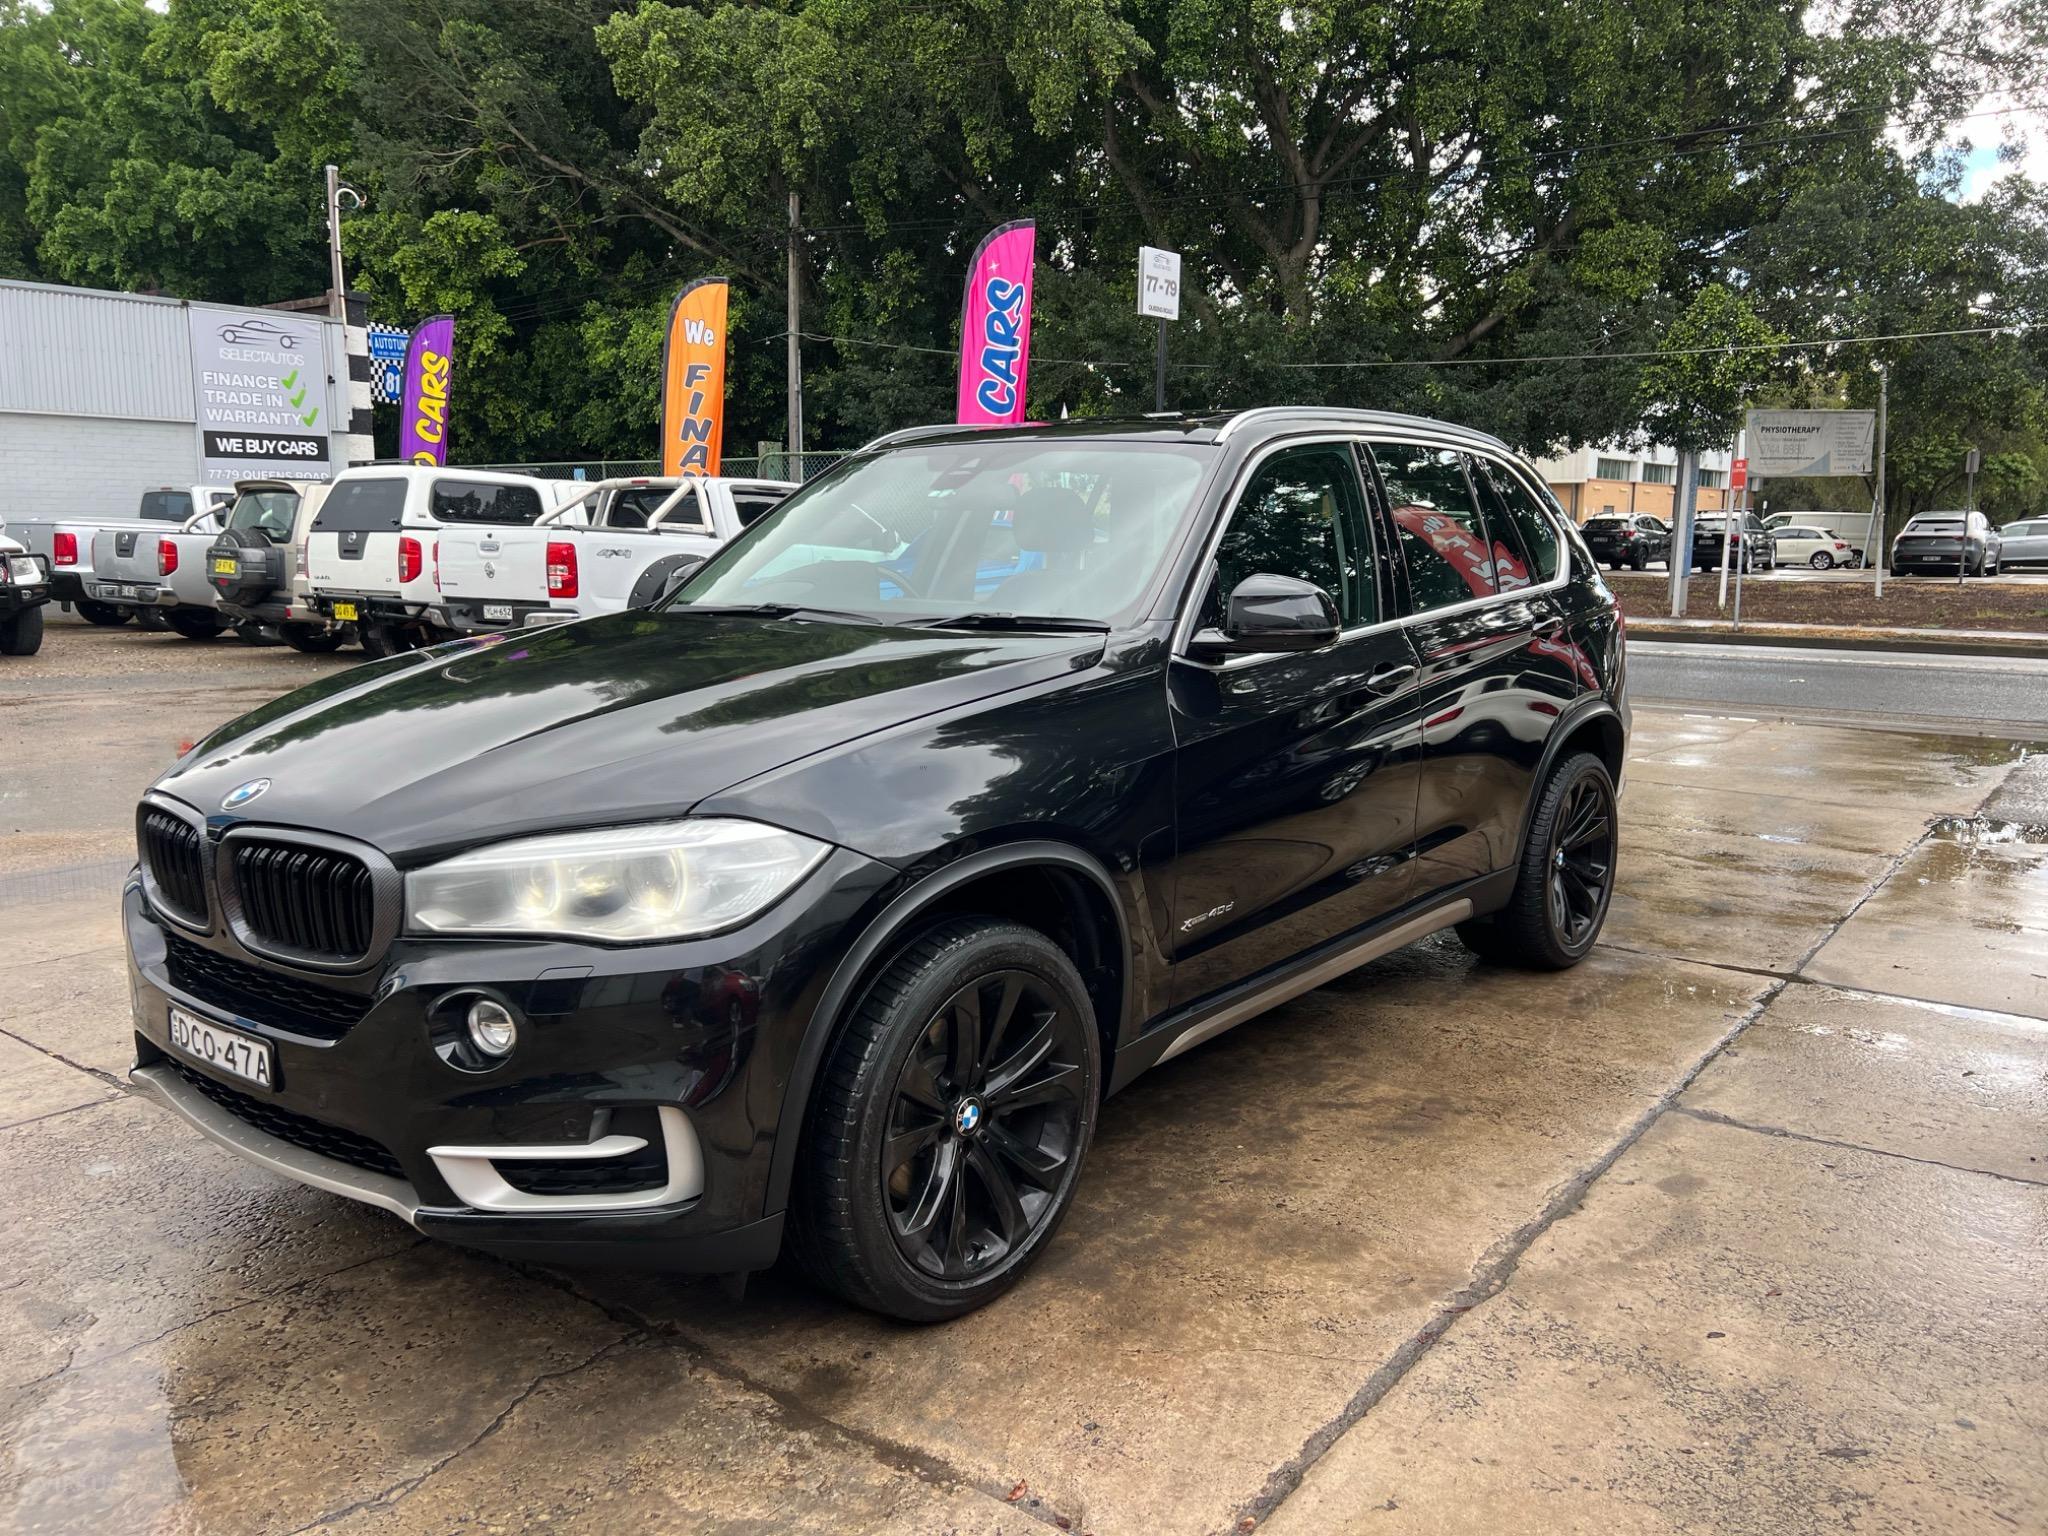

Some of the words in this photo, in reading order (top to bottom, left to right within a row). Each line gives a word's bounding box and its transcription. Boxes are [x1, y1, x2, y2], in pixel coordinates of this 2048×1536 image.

[1146, 274, 1178, 297] 77-79
[684, 318, 714, 347] We
[976, 277, 1025, 416] CARS
[203, 371, 279, 390] FINANCE
[385, 371, 400, 394] 81
[204, 389, 263, 406] TRADE
[266, 393, 283, 408] IN
[415, 350, 450, 444] CARS
[206, 407, 302, 426] WARRANTY
[680, 363, 714, 477] FINA
[1760, 426, 1821, 434] PHYSIOTHERAPY
[216, 437, 244, 453] WE
[245, 438, 276, 454] BUY
[277, 440, 319, 456] CARS
[208, 468, 240, 480] 77-79
